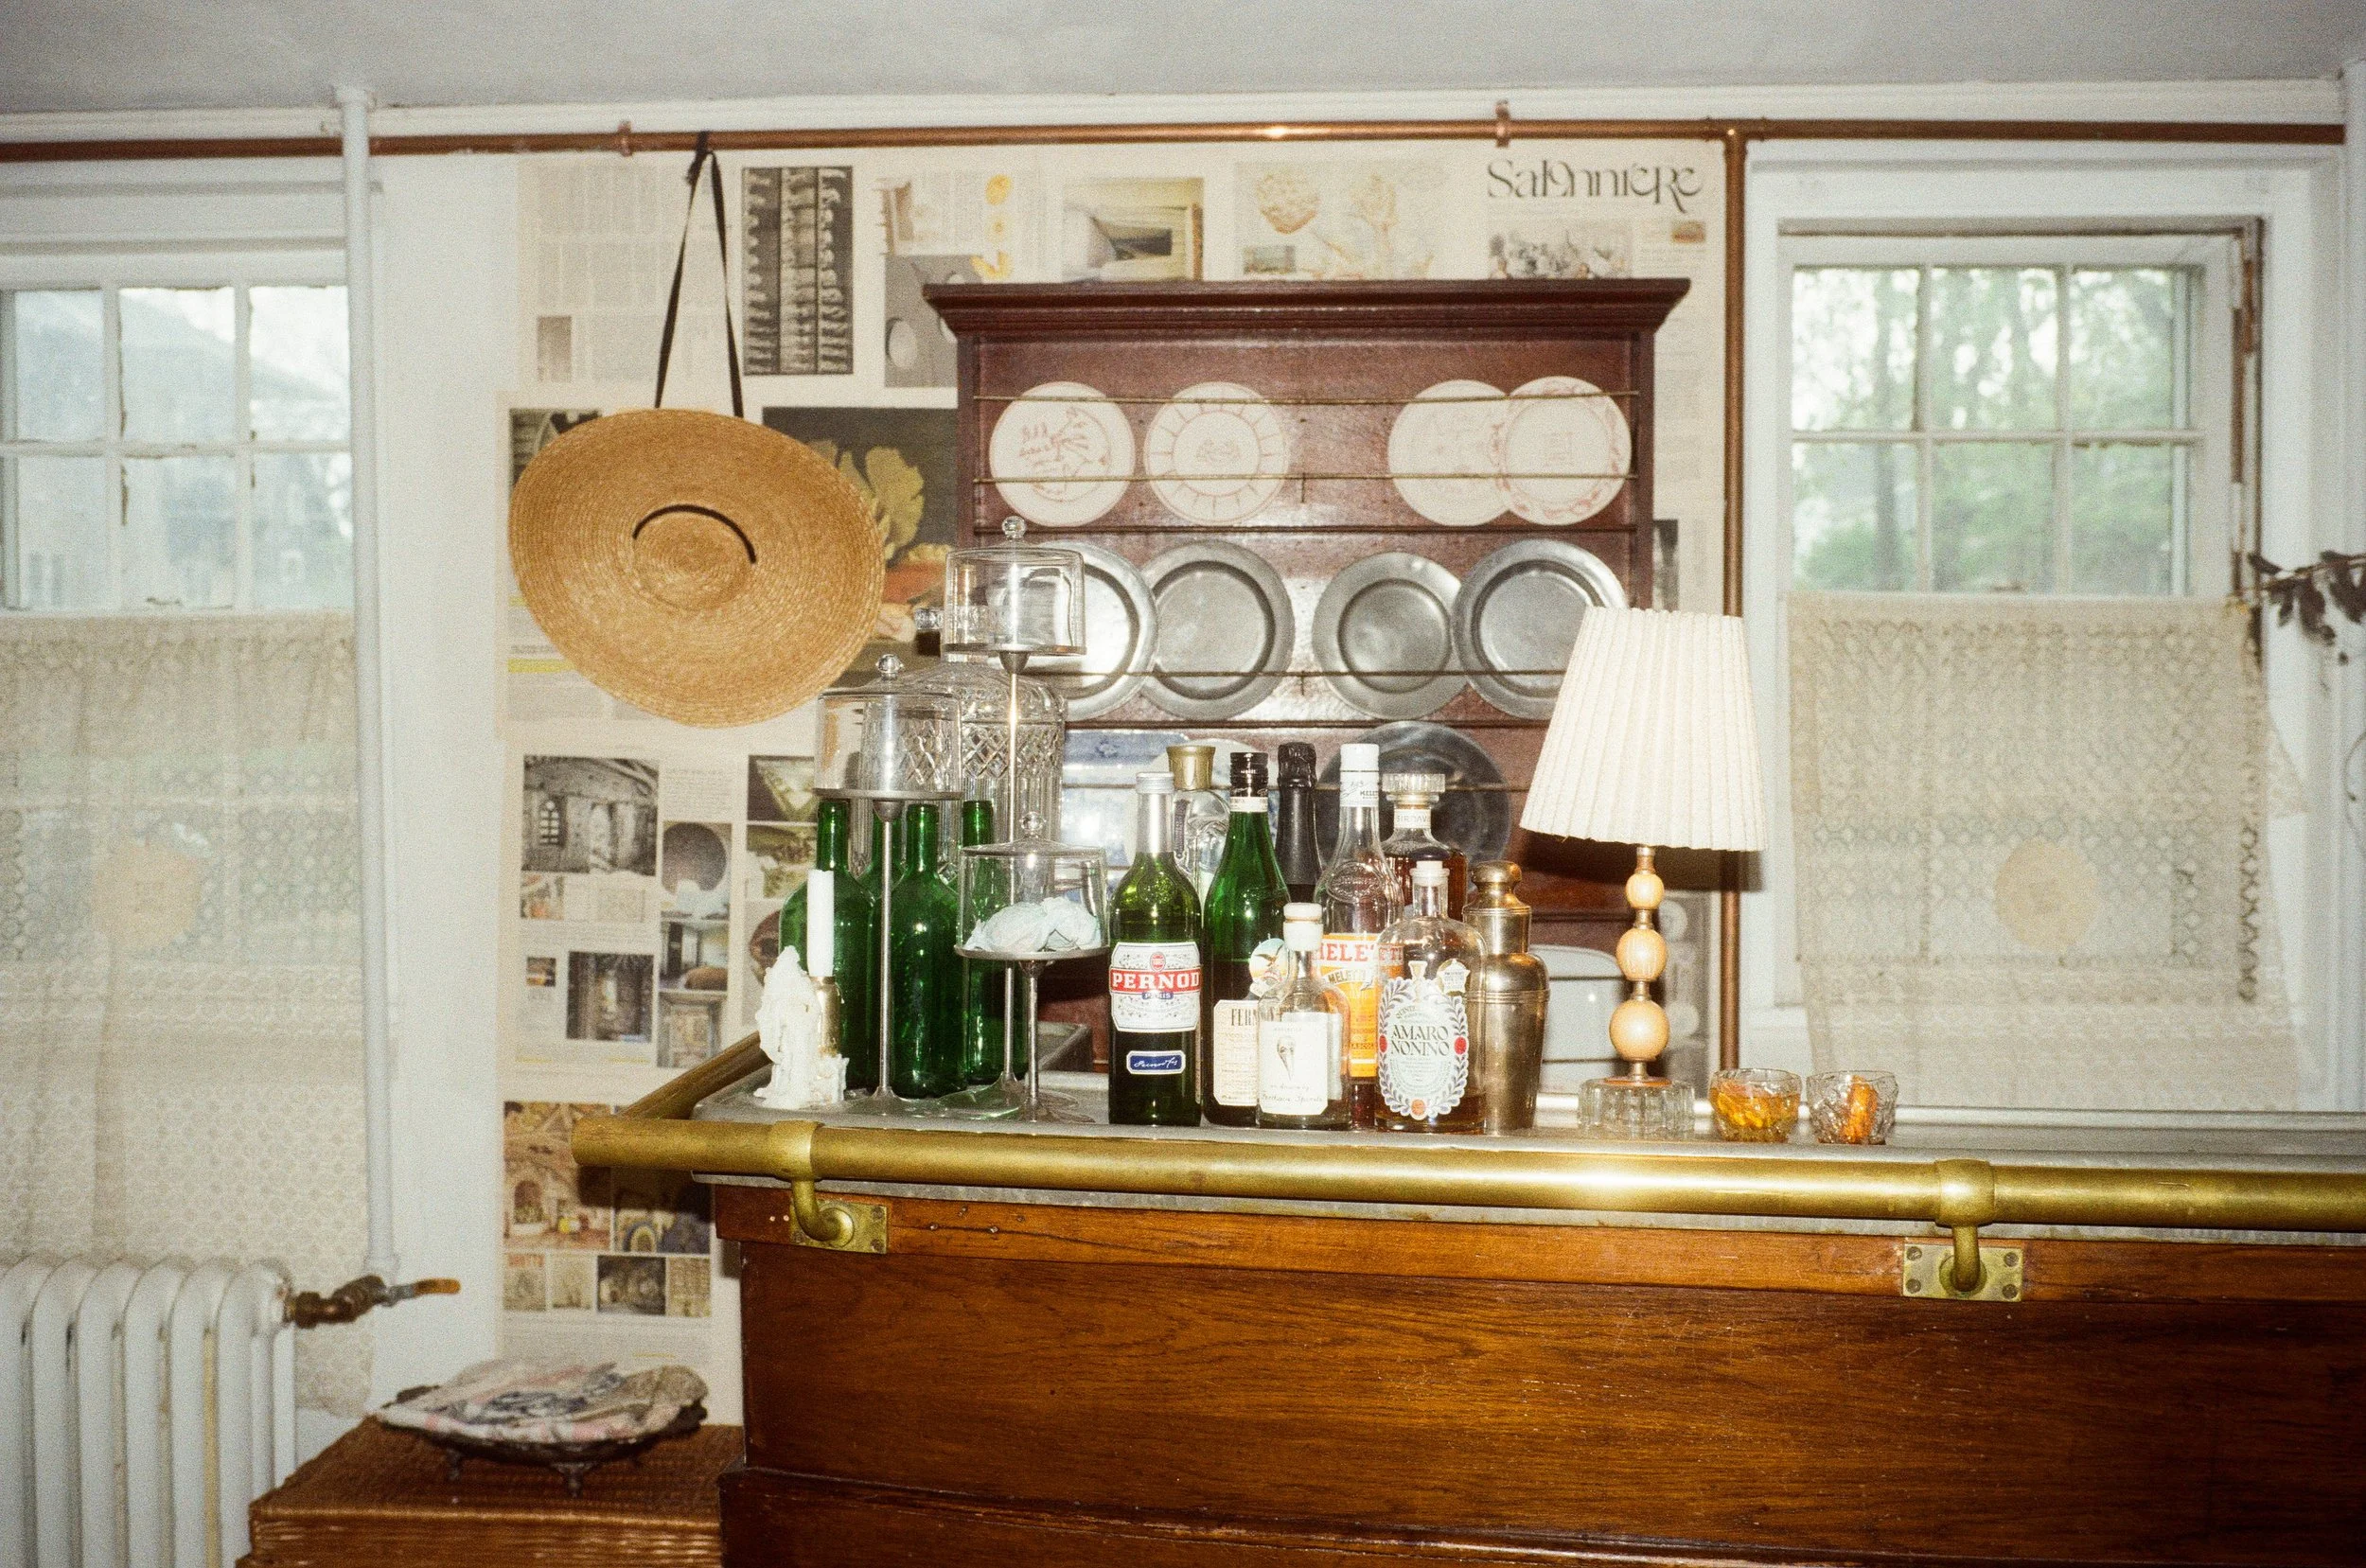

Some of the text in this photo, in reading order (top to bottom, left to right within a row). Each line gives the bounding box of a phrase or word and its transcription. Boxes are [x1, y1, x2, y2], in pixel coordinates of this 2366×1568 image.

[1112, 972, 1200, 990] PERNOD
[1391, 1024, 1449, 1041] AMARO
[1390, 1039, 1450, 1056] NONINO
